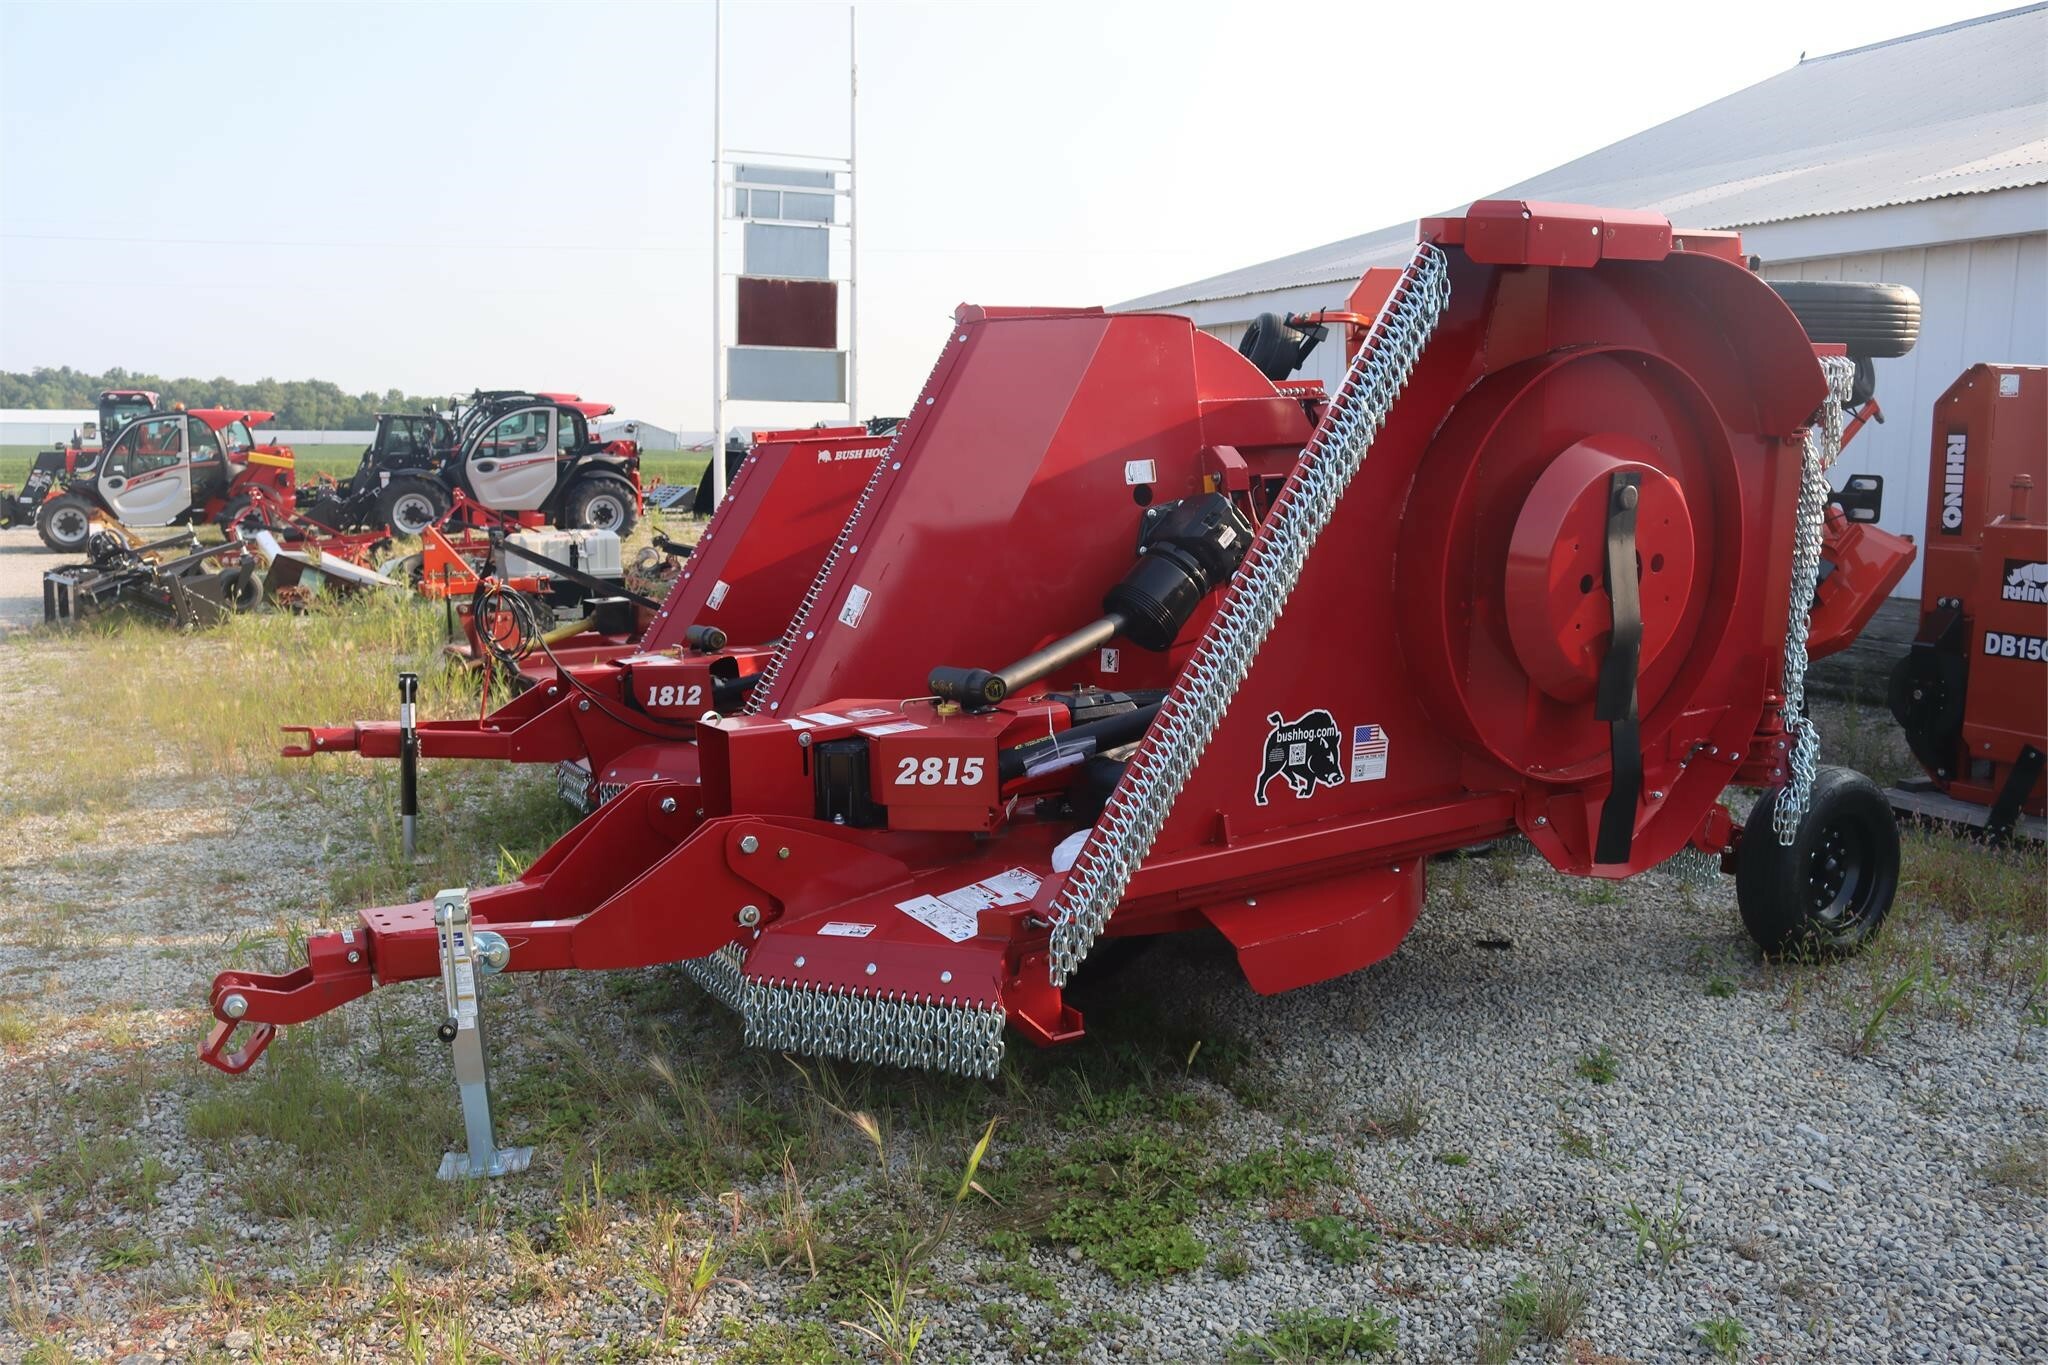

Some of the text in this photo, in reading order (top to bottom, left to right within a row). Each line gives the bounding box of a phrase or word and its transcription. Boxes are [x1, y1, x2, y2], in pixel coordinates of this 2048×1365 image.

[834, 448, 864, 461] BUSH
[1942, 434, 1966, 529] RHINO
[647, 685, 702, 706] 1812
[1276, 727, 1335, 743] bushhog.com
[894, 756, 985, 786] 2815
